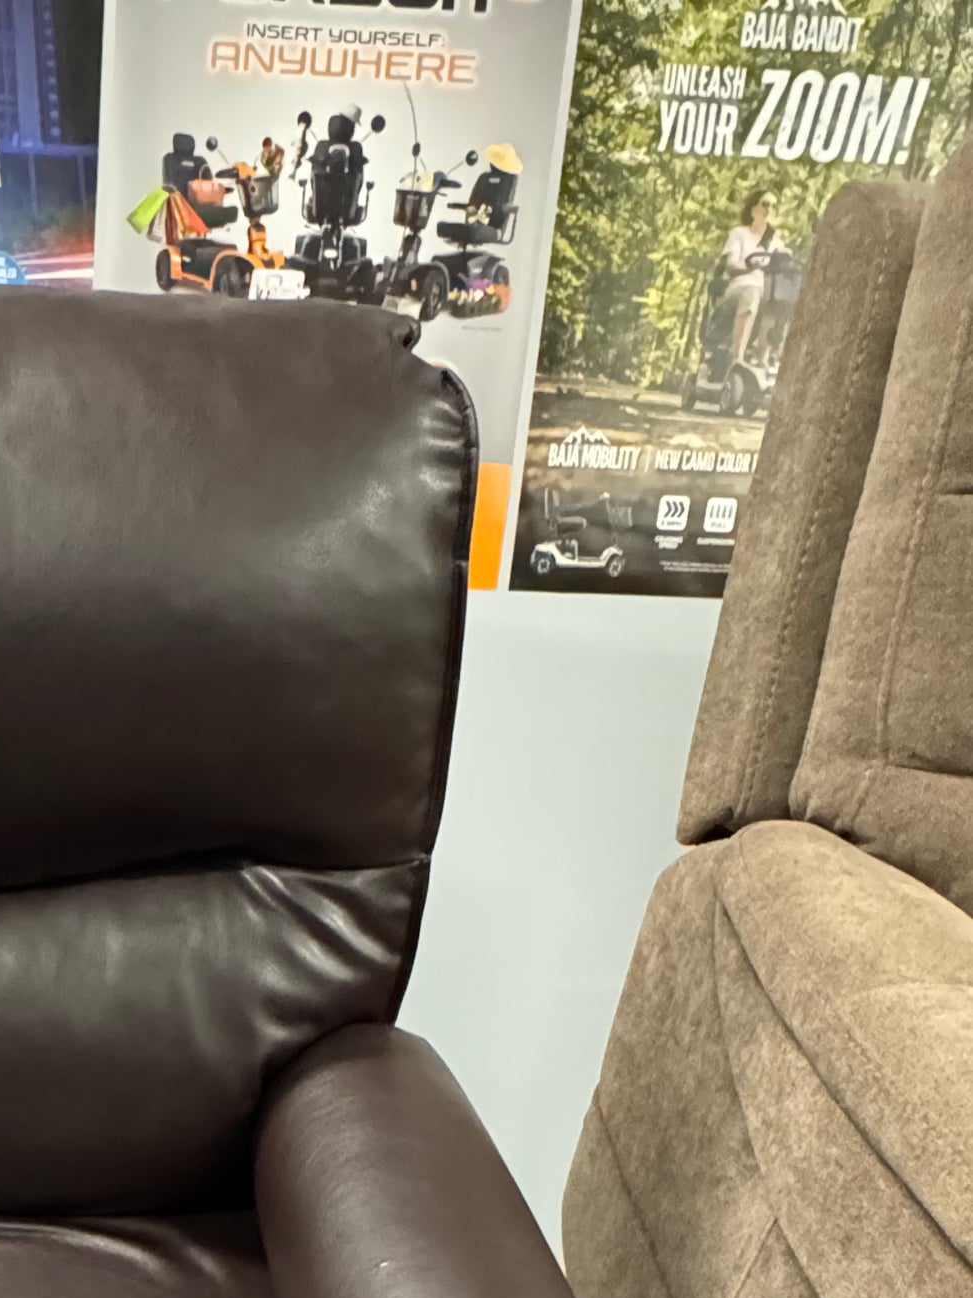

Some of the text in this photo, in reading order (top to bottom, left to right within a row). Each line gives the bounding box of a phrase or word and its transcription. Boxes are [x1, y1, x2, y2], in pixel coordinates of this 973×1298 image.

[246, 23, 445, 48] INSERT YOURSELF:
[740, 11, 866, 54] BAJA BANDIT
[210, 41, 476, 84] ANYWHERE
[657, 100, 739, 156] YOUR
[663, 63, 931, 165] UNLEASH ZOOM!
[548, 443, 579, 467] BAJA
[581, 445, 641, 471] MOBILITY
[654, 449, 682, 470] NEW
[682, 450, 715, 472] CAMO
[715, 452, 750, 473] COLOR
